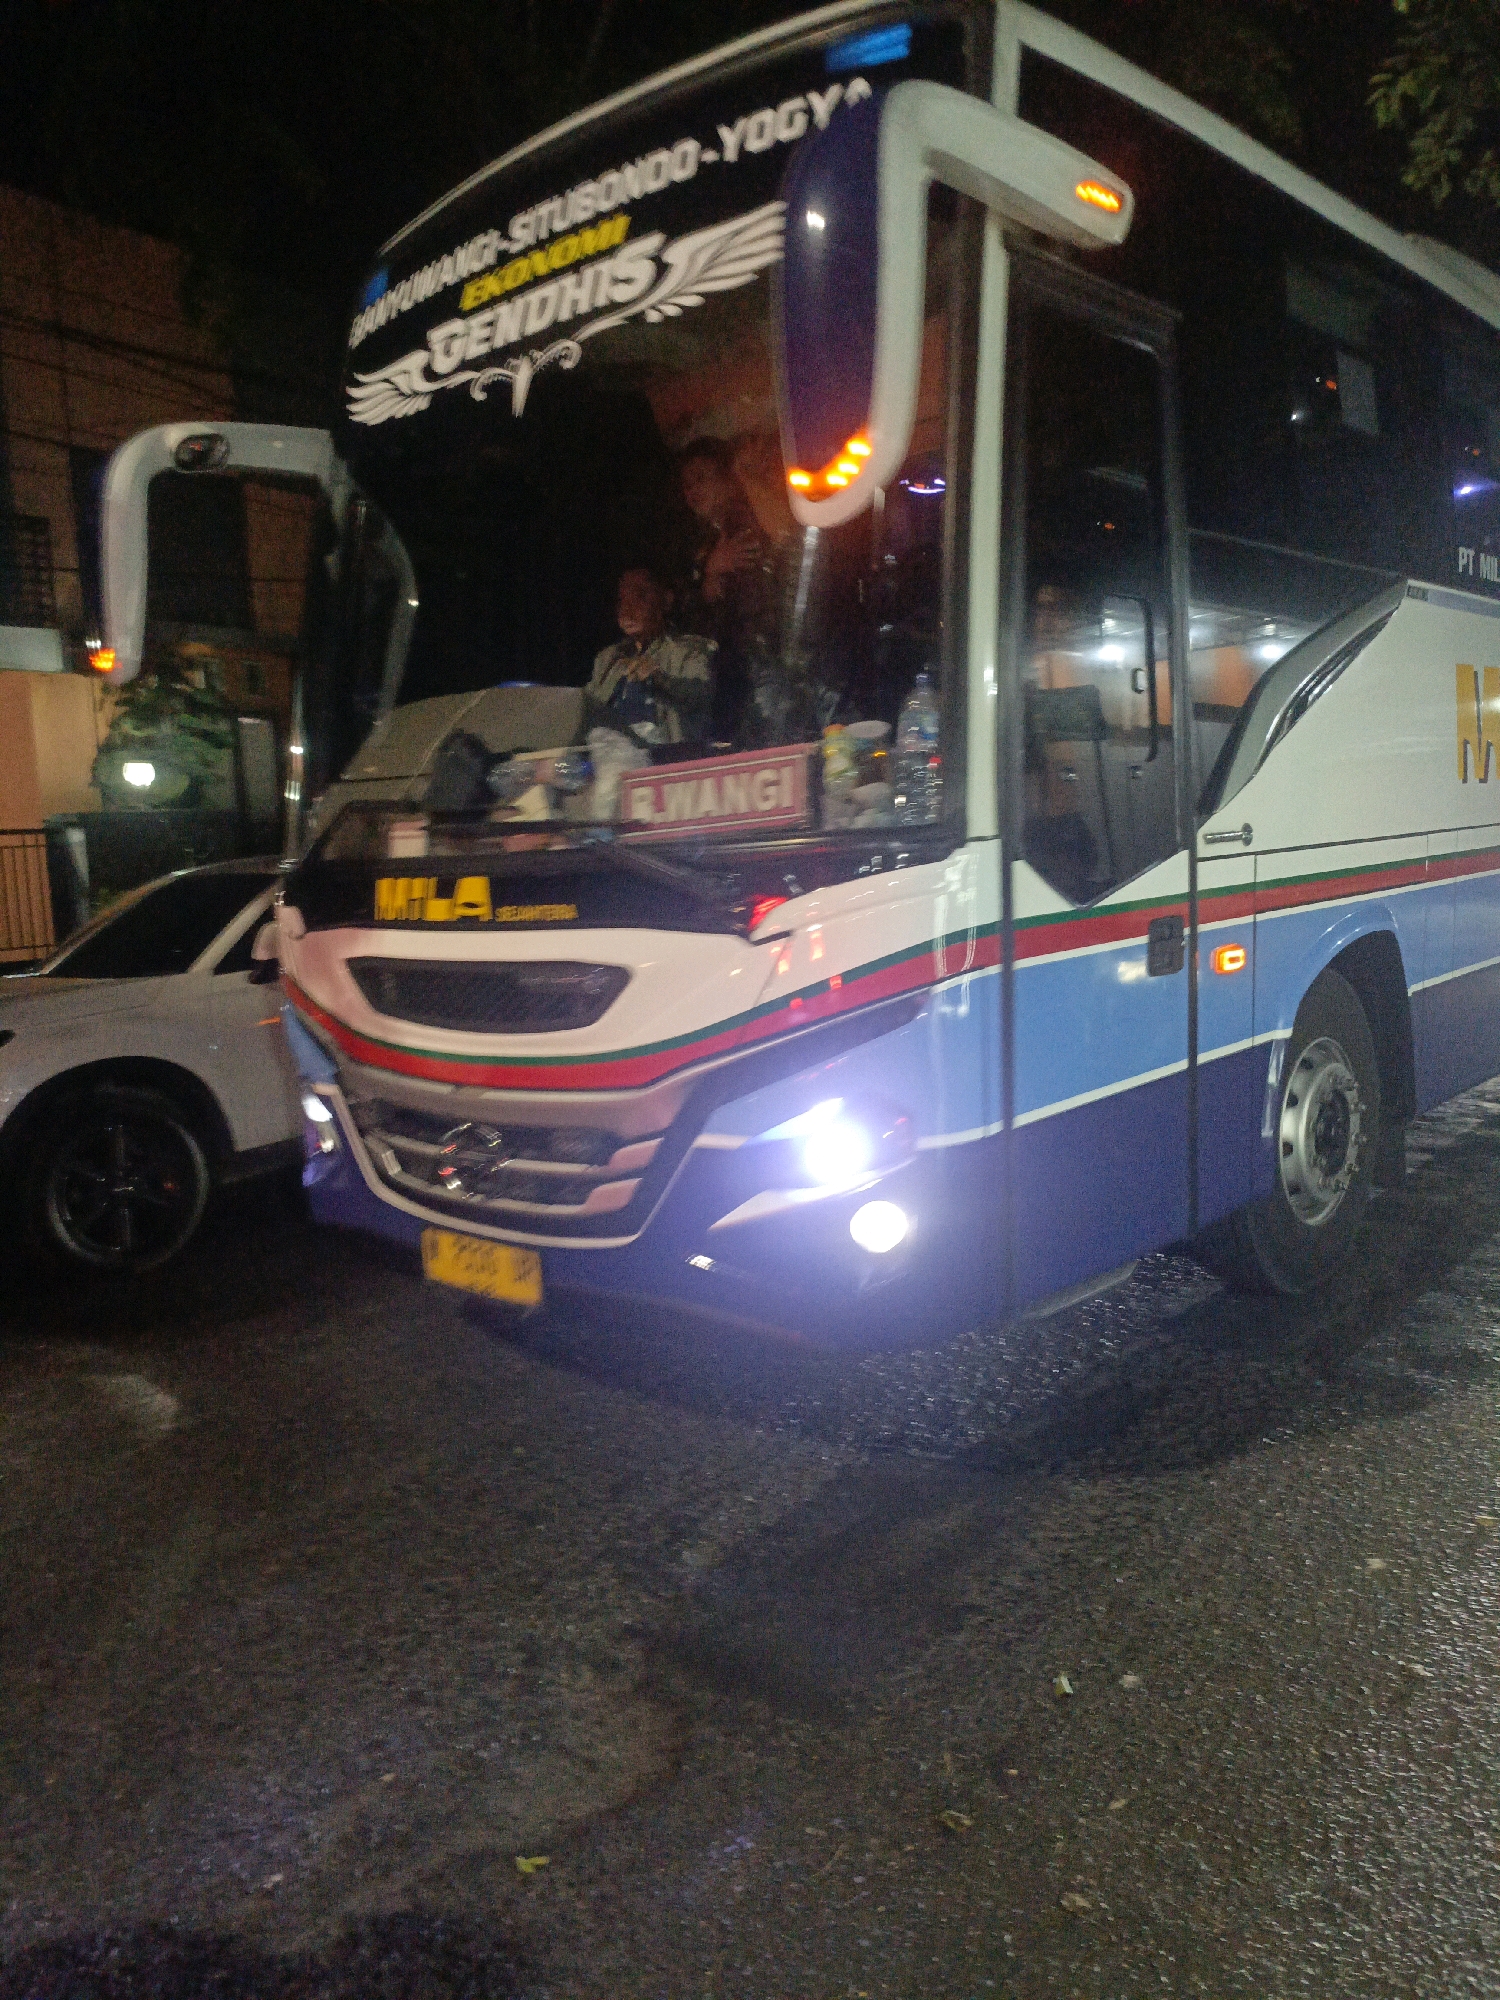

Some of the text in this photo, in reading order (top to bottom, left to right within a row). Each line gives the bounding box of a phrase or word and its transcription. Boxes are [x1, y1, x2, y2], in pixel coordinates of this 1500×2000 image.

[459, 213, 632, 312] EKONOMI
[426, 231, 666, 374] GENDHIS
[1458, 546, 1476, 576] PT
[374, 876, 492, 922] MILA
